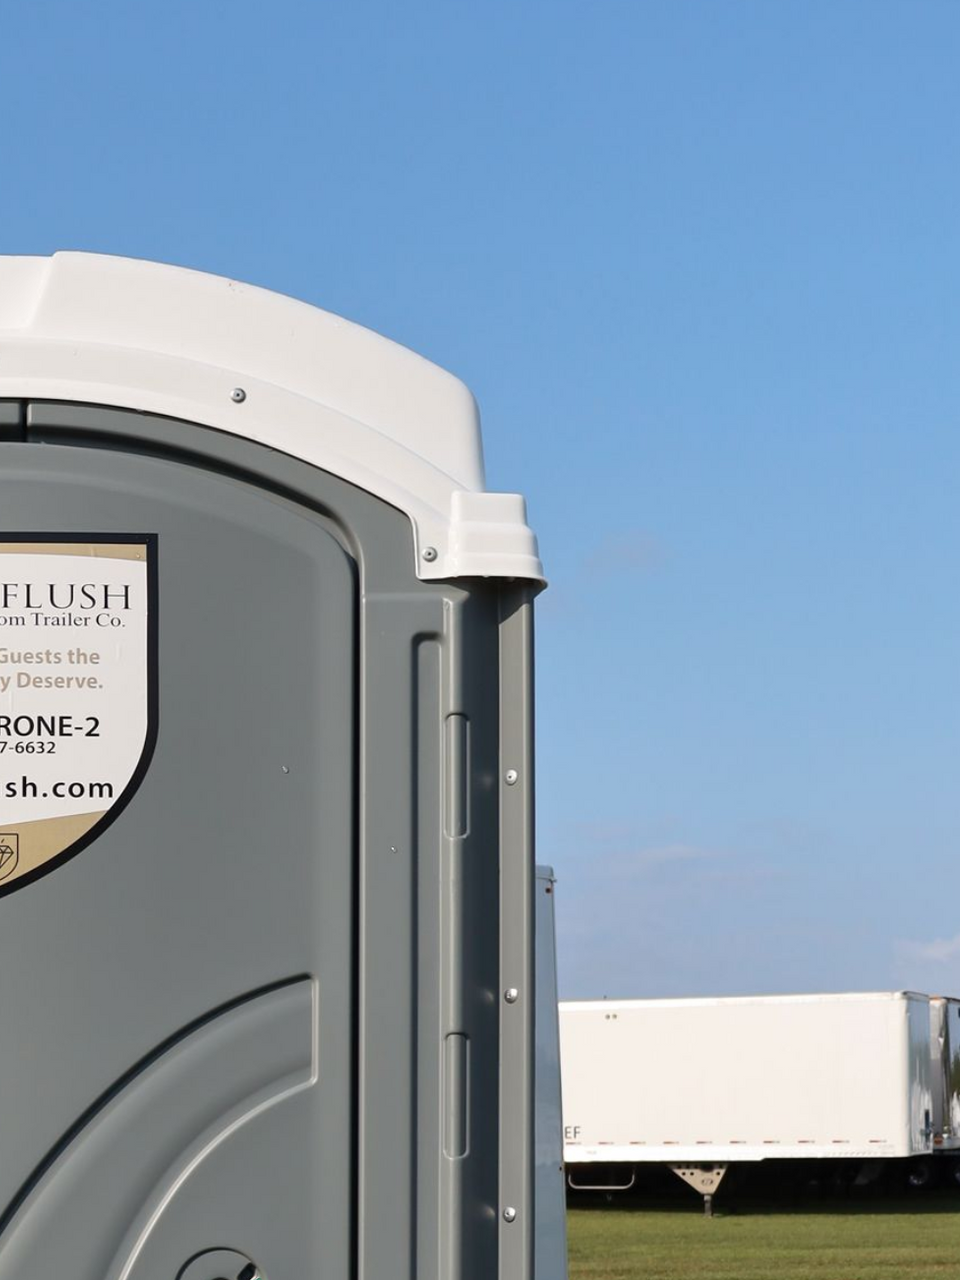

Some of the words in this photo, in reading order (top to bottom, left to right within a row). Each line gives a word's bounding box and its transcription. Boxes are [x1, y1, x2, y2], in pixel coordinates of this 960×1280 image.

[1, 583, 132, 610] FLUSH
[30, 612, 91, 627] Trailer
[96, 612, 126, 627] Co.
[67, 647, 100, 665] the
[17, 672, 103, 689] Deserve.
